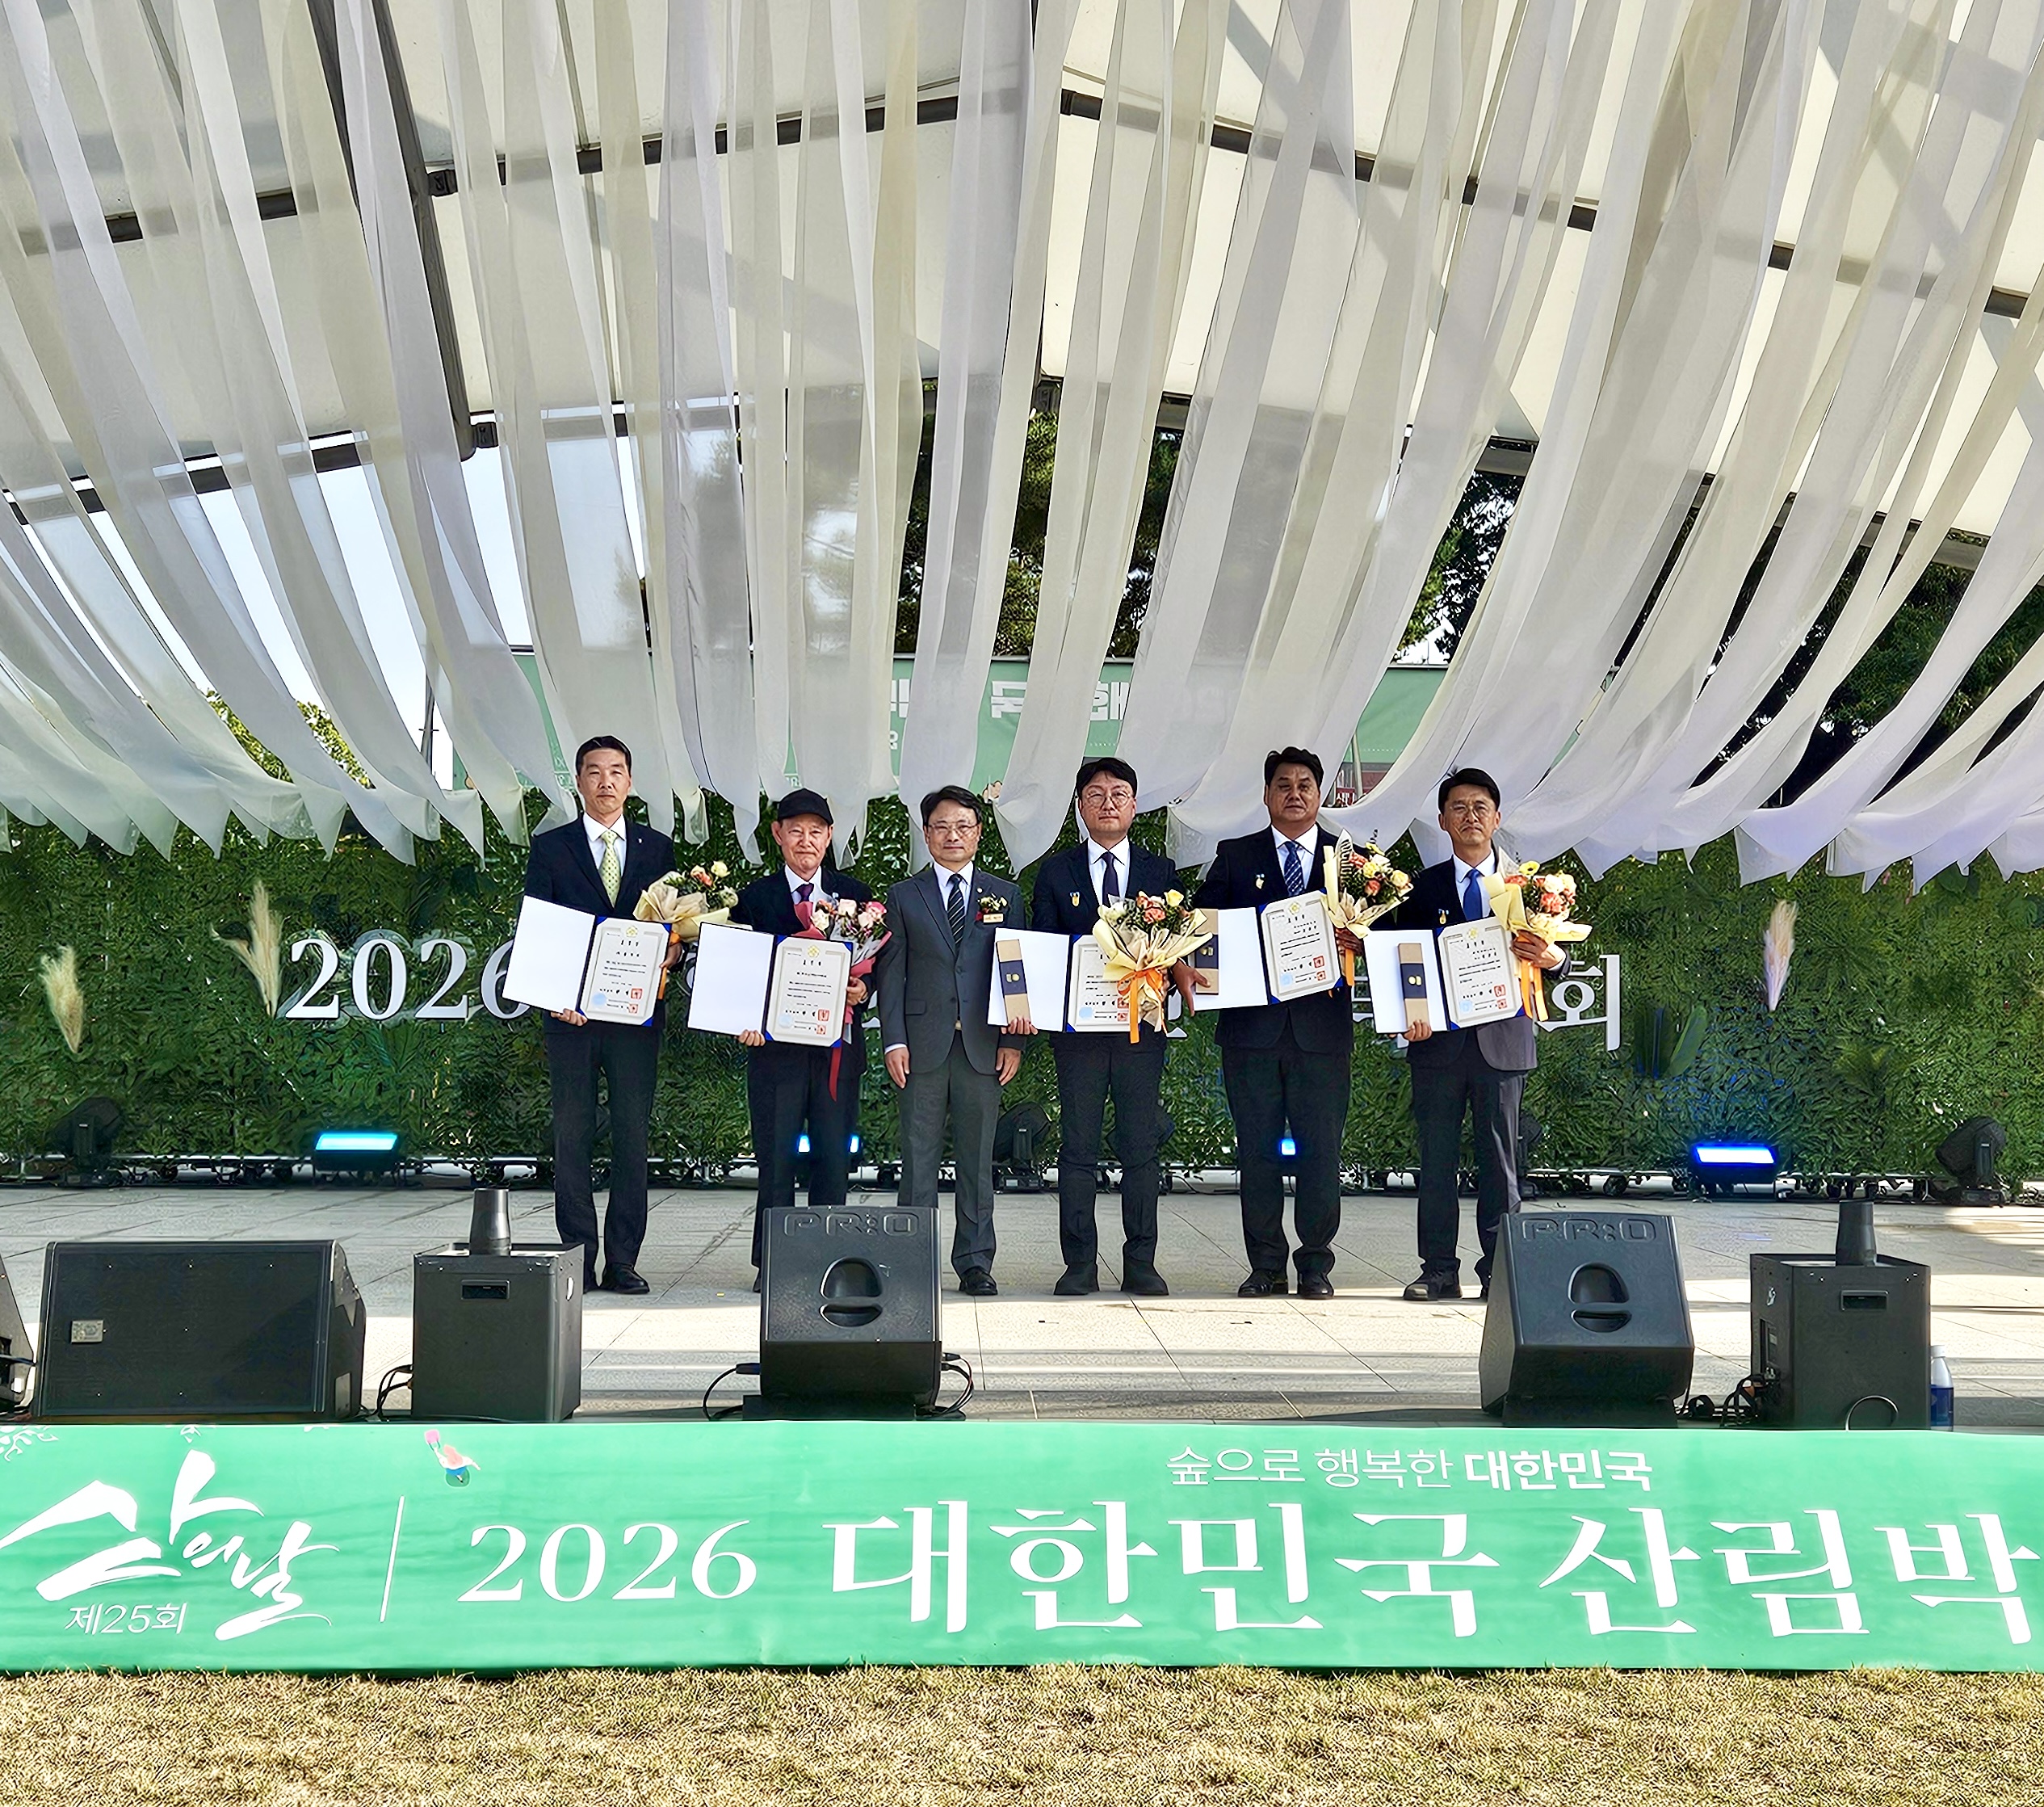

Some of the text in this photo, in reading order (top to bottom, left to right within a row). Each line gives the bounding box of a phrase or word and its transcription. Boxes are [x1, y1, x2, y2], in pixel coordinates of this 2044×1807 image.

[1166, 1446, 1653, 1492] 숲으로 행복한 대한민국
[456, 1519, 758, 1603] 2026
[64, 1602, 188, 1635] 제25회
